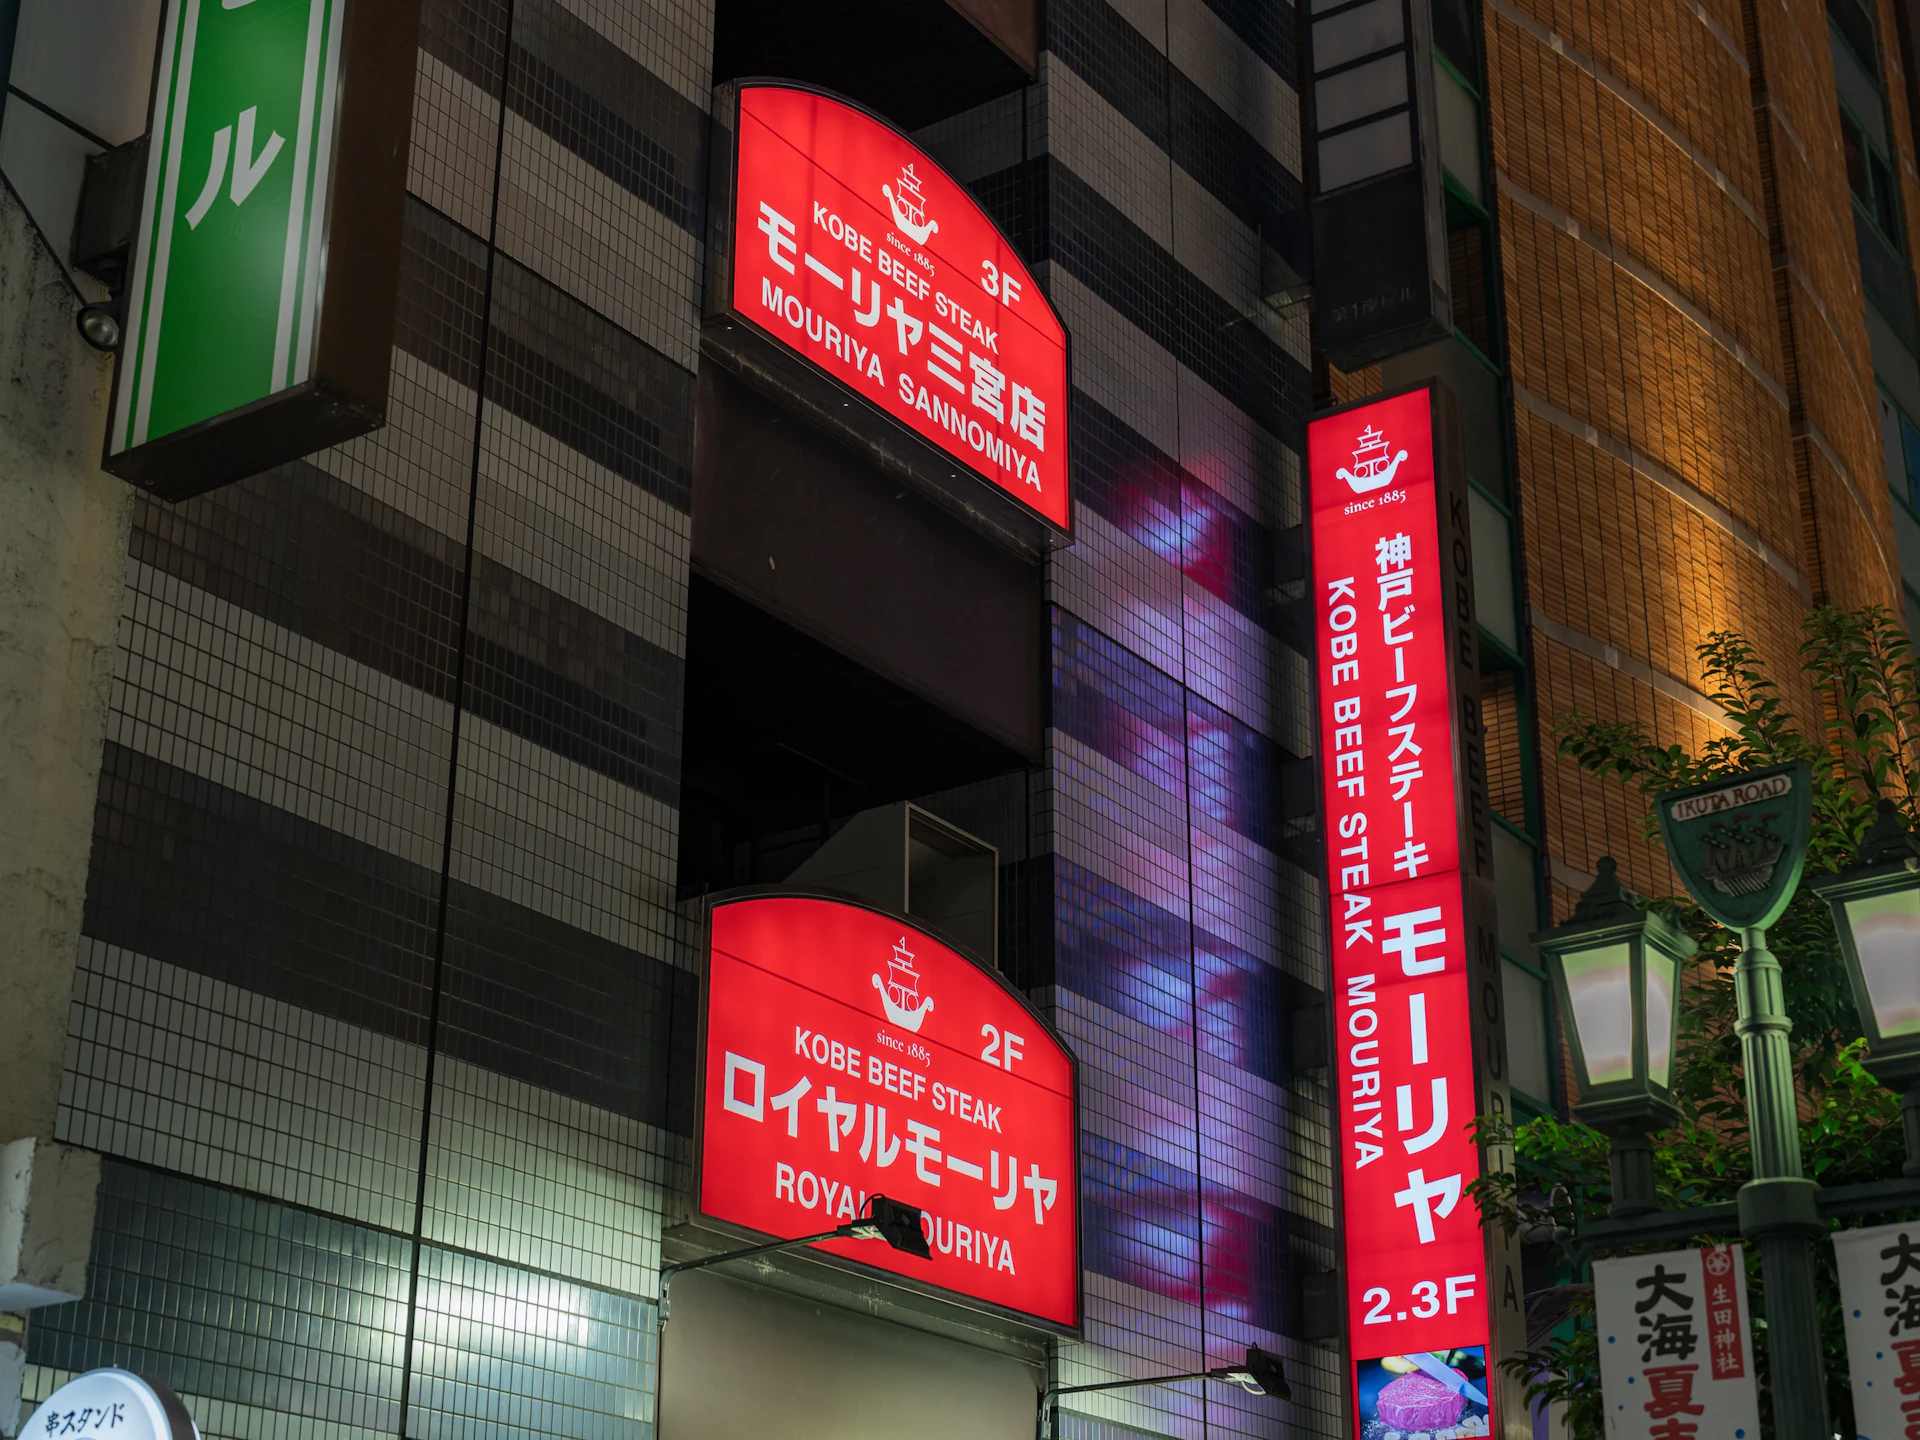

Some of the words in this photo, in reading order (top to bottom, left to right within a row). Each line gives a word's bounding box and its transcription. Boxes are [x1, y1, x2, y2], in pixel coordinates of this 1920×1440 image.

[813, 200, 872, 264] KOBE
[878, 248, 931, 301] BEEF
[935, 291, 999, 355] STEAK
[886, 232, 911, 257] since
[913, 251, 935, 277] 1885
[980, 259, 1022, 307] 3F
[757, 200, 1046, 453] モーリヤ三宮店
[761, 276, 885, 387] MOURIYA
[898, 372, 1042, 493] SANNOMIYA
[1344, 498, 1375, 516] since
[1378, 489, 1407, 507] 1885
[1328, 576, 1360, 687] KOBE
[1449, 490, 1472, 670] KOBE
[1463, 695, 1487, 877] BEEF
[1333, 696, 1365, 798] BEEF
[1375, 531, 1429, 879] 神戸ビーフステーキ
[1676, 793, 1730, 819] IKUTA
[1732, 777, 1787, 804] ROAD
[1338, 812, 1374, 950] STEAK
[795, 1025, 861, 1079] KOBE
[868, 1055, 927, 1101] BEEF
[931, 1081, 1002, 1134] STEAK
[876, 1030, 904, 1053] since
[906, 1043, 931, 1068] 1885
[980, 1023, 1025, 1072] 2F
[1347, 973, 1384, 1170] MOURIYA
[1381, 905, 1462, 1245] モーリヤ
[723, 1050, 1058, 1226] ロイヤルモーリヤ
[920, 1210, 1016, 1276] OURIYA
[1362, 1274, 1476, 1325] 2.3F
[1711, 1283, 1740, 1374] 生田神社
[44, 1403, 125, 1439] 串スタンド
